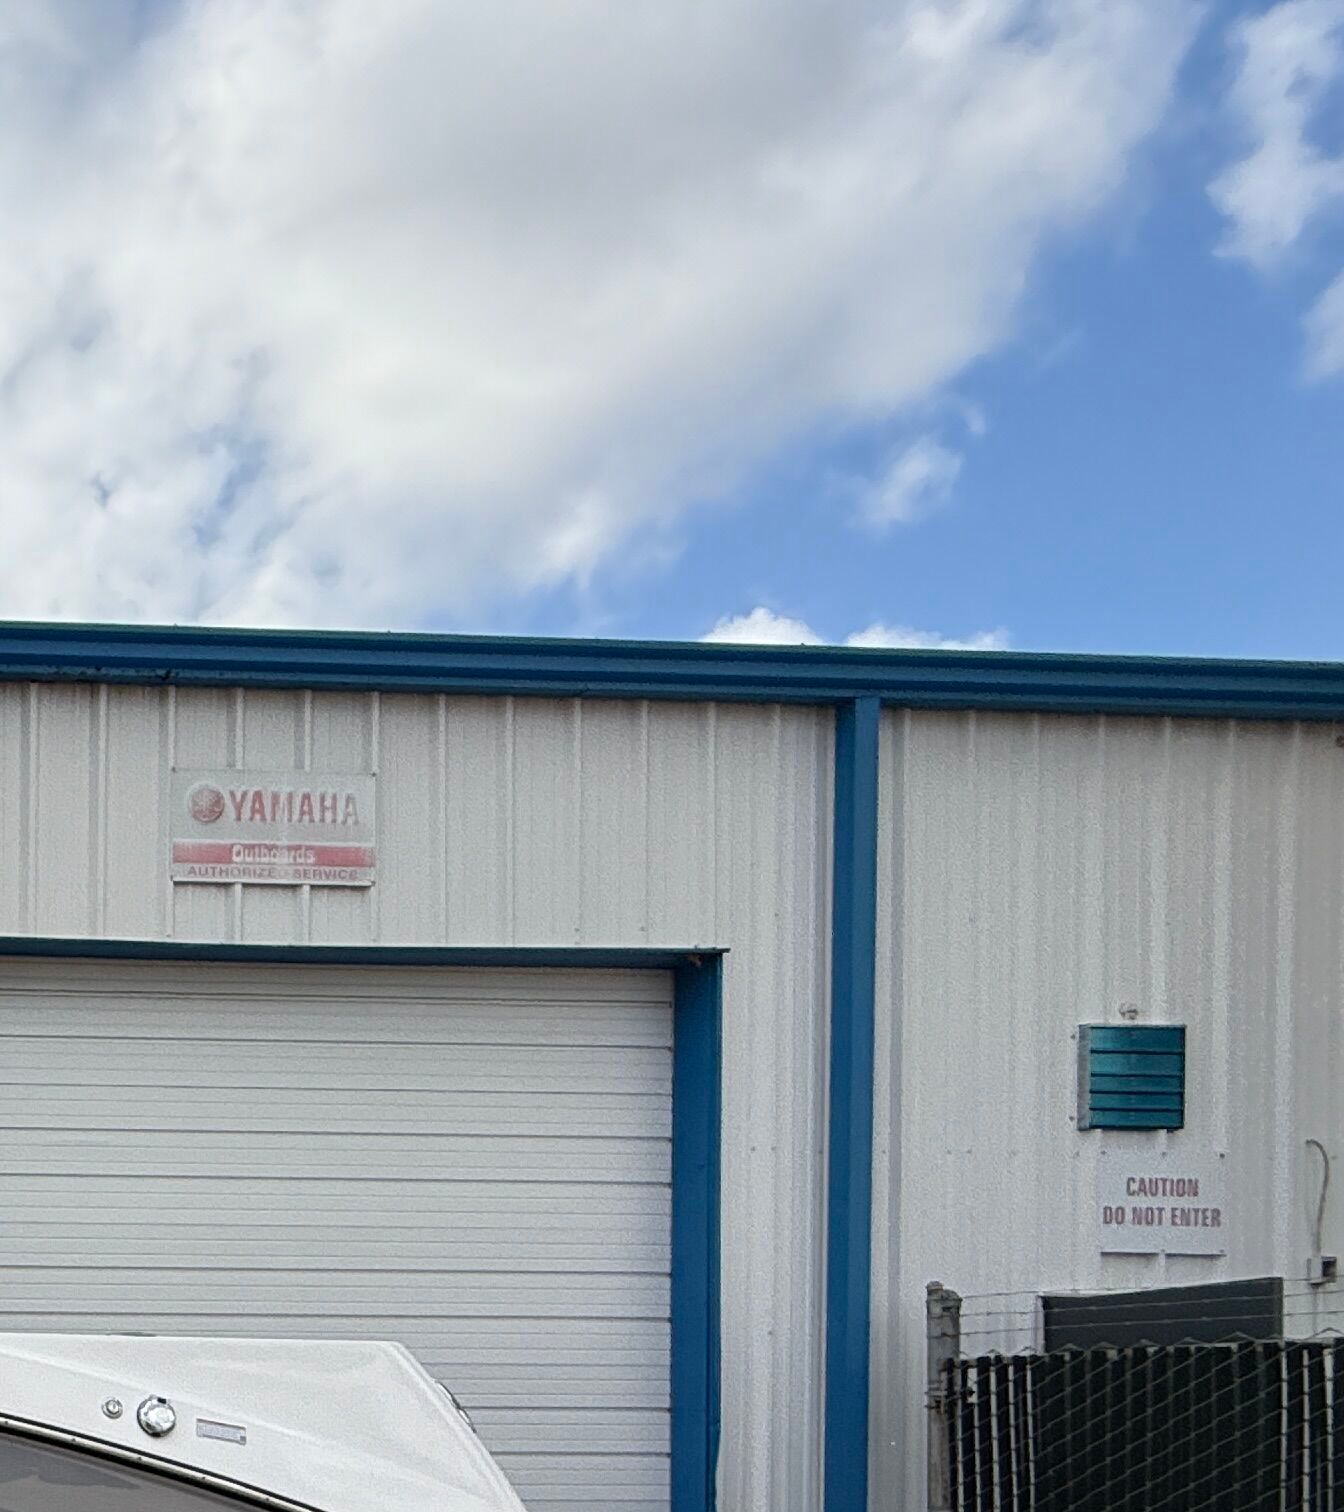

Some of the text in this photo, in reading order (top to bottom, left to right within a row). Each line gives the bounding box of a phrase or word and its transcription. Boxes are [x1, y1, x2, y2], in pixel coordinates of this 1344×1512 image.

[228, 788, 360, 826] YAMAHA
[187, 864, 359, 881] AUTHORIZE SERVICE
[1125, 1176, 1200, 1198] CAUTION
[1102, 1206, 1222, 1228] DO NOT ENTER
